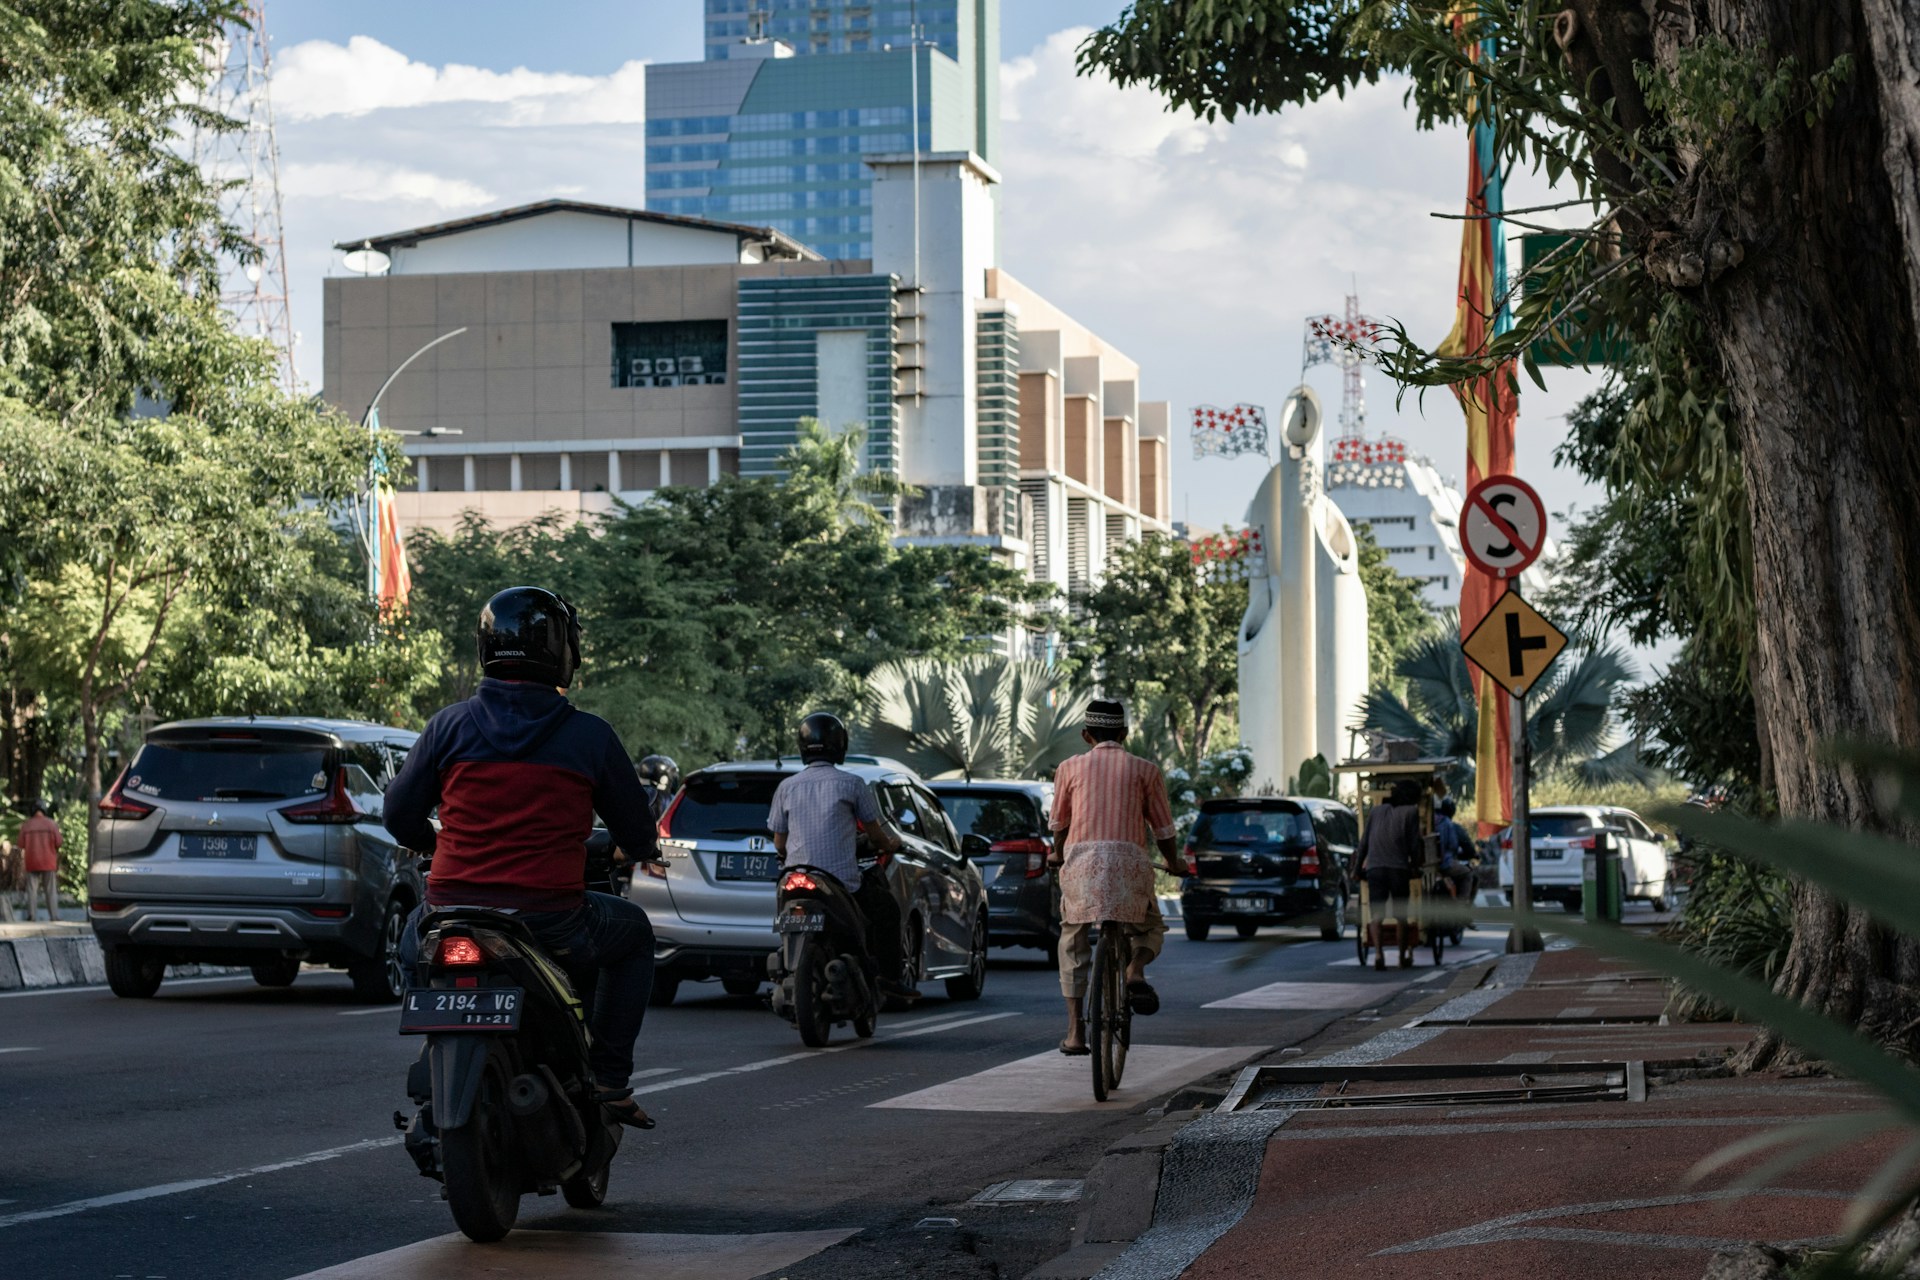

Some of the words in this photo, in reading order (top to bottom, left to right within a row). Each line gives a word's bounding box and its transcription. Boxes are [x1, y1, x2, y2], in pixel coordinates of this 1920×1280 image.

[180, 836, 188, 850] L
[202, 836, 228, 850] 1596
[240, 837, 254, 851] CX
[720, 855, 734, 869] AE
[743, 856, 769, 870] 1757
[811, 914, 823, 923] AY
[409, 995, 419, 1011] L
[435, 995, 477, 1011] 2194
[495, 994, 516, 1011] VG
